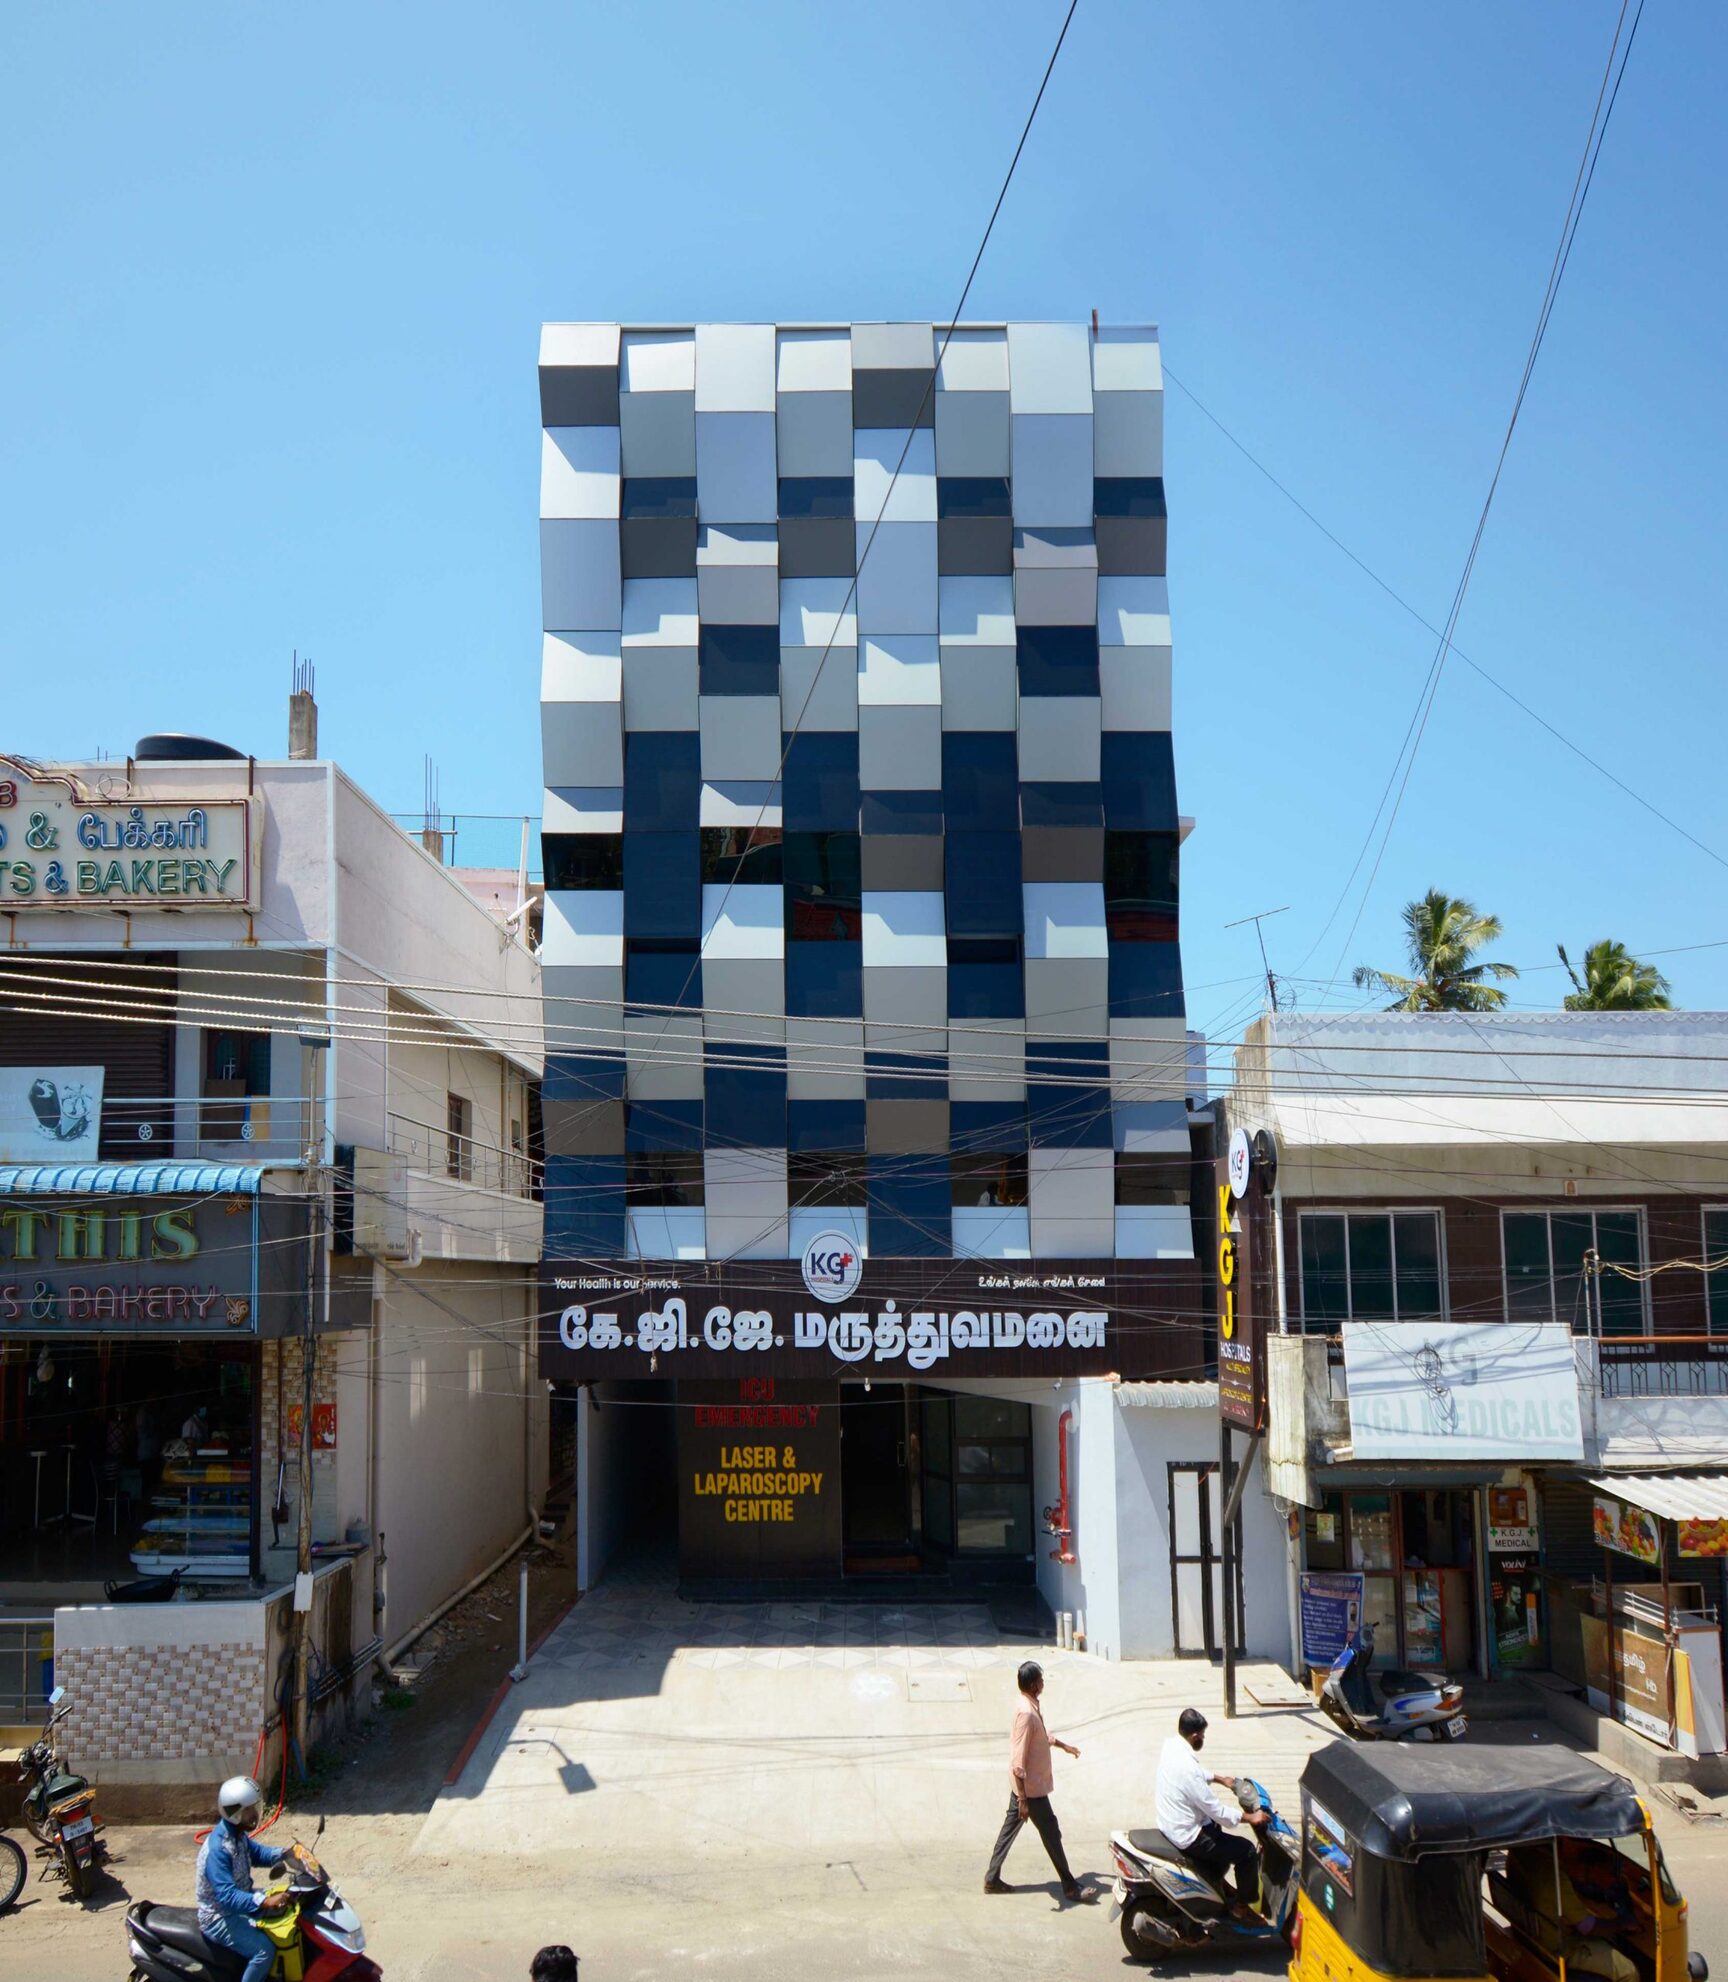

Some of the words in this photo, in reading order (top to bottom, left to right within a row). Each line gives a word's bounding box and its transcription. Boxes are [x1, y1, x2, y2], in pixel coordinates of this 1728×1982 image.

[77, 807, 208, 850] பேக்கரி
[44, 860, 69, 895] &
[77, 859, 237, 896] BAKERY
[554, 1278, 576, 1289] Your
[613, 1278, 621, 1289] is
[623, 1279, 639, 1289] our
[30, 1281, 58, 1320] &
[68, 1284, 217, 1320] BAKERY
[794, 1299, 1109, 1370] மருத்துவமனை
[740, 1376, 775, 1401] ICU
[695, 1405, 820, 1427] EMERGENCY
[721, 1446, 776, 1469] LASER
[783, 1446, 796, 1469] &
[694, 1473, 823, 1496] LAPAROSCOPY
[725, 1500, 794, 1522] CENTRE
